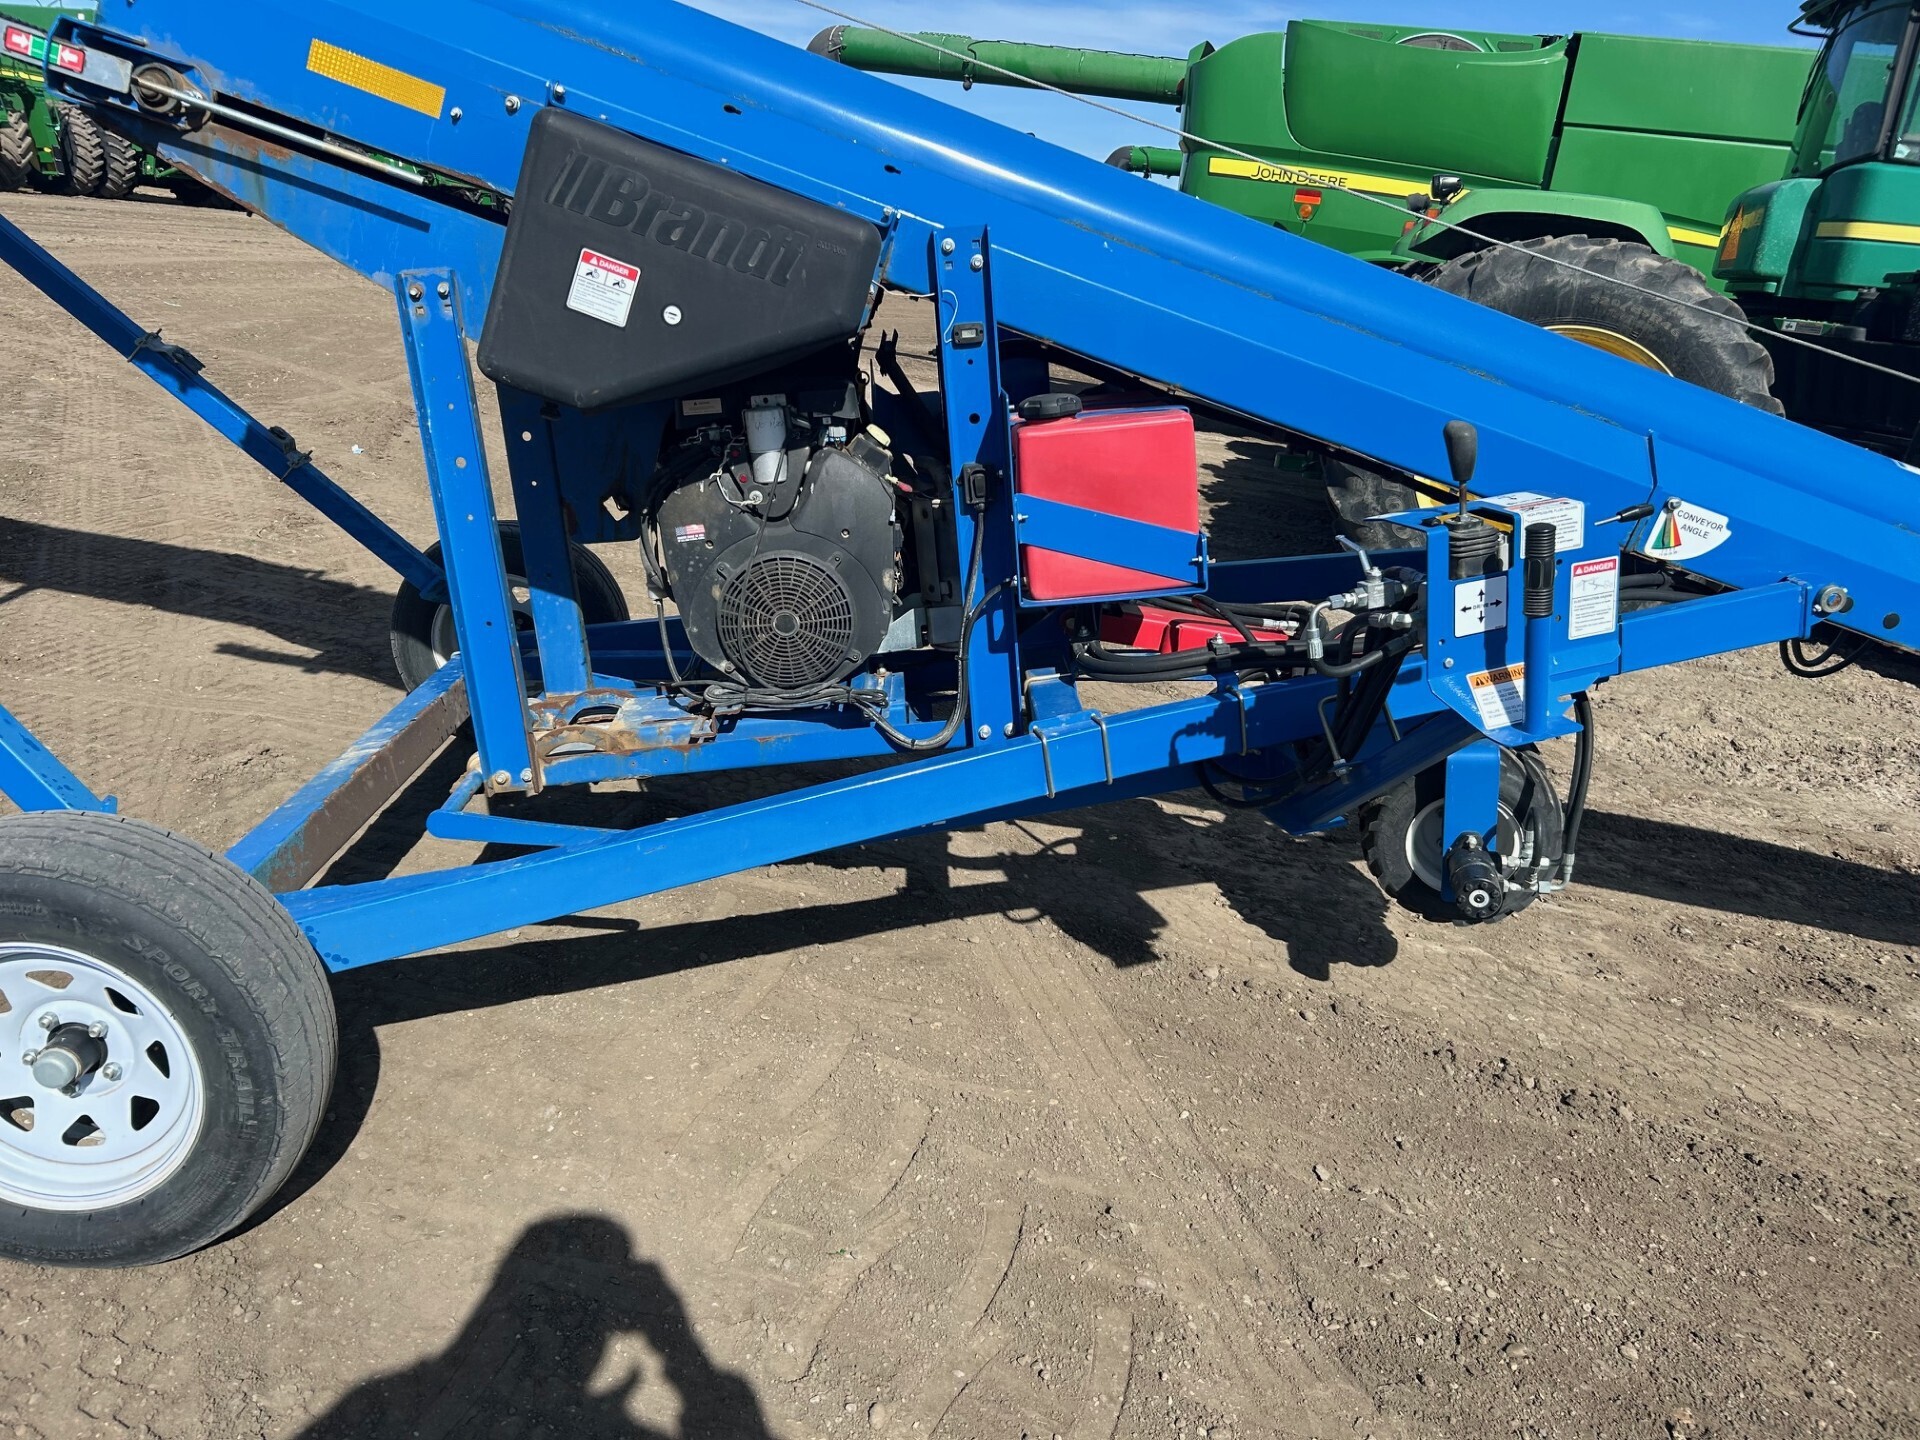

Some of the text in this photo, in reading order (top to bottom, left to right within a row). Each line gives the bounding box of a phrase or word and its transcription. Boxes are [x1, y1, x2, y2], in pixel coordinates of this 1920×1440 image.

[1251, 165, 1348, 187] JOHN DEERE
[588, 163, 813, 287] Brandt
[598, 259, 629, 276] DANGER
[1677, 509, 1724, 532] CONVEYOR
[1680, 523, 1710, 540] ANGLE
[1583, 561, 1614, 574] DANGER
[1472, 602, 1490, 610] DRIVE
[121, 932, 223, 1019] SPORT
